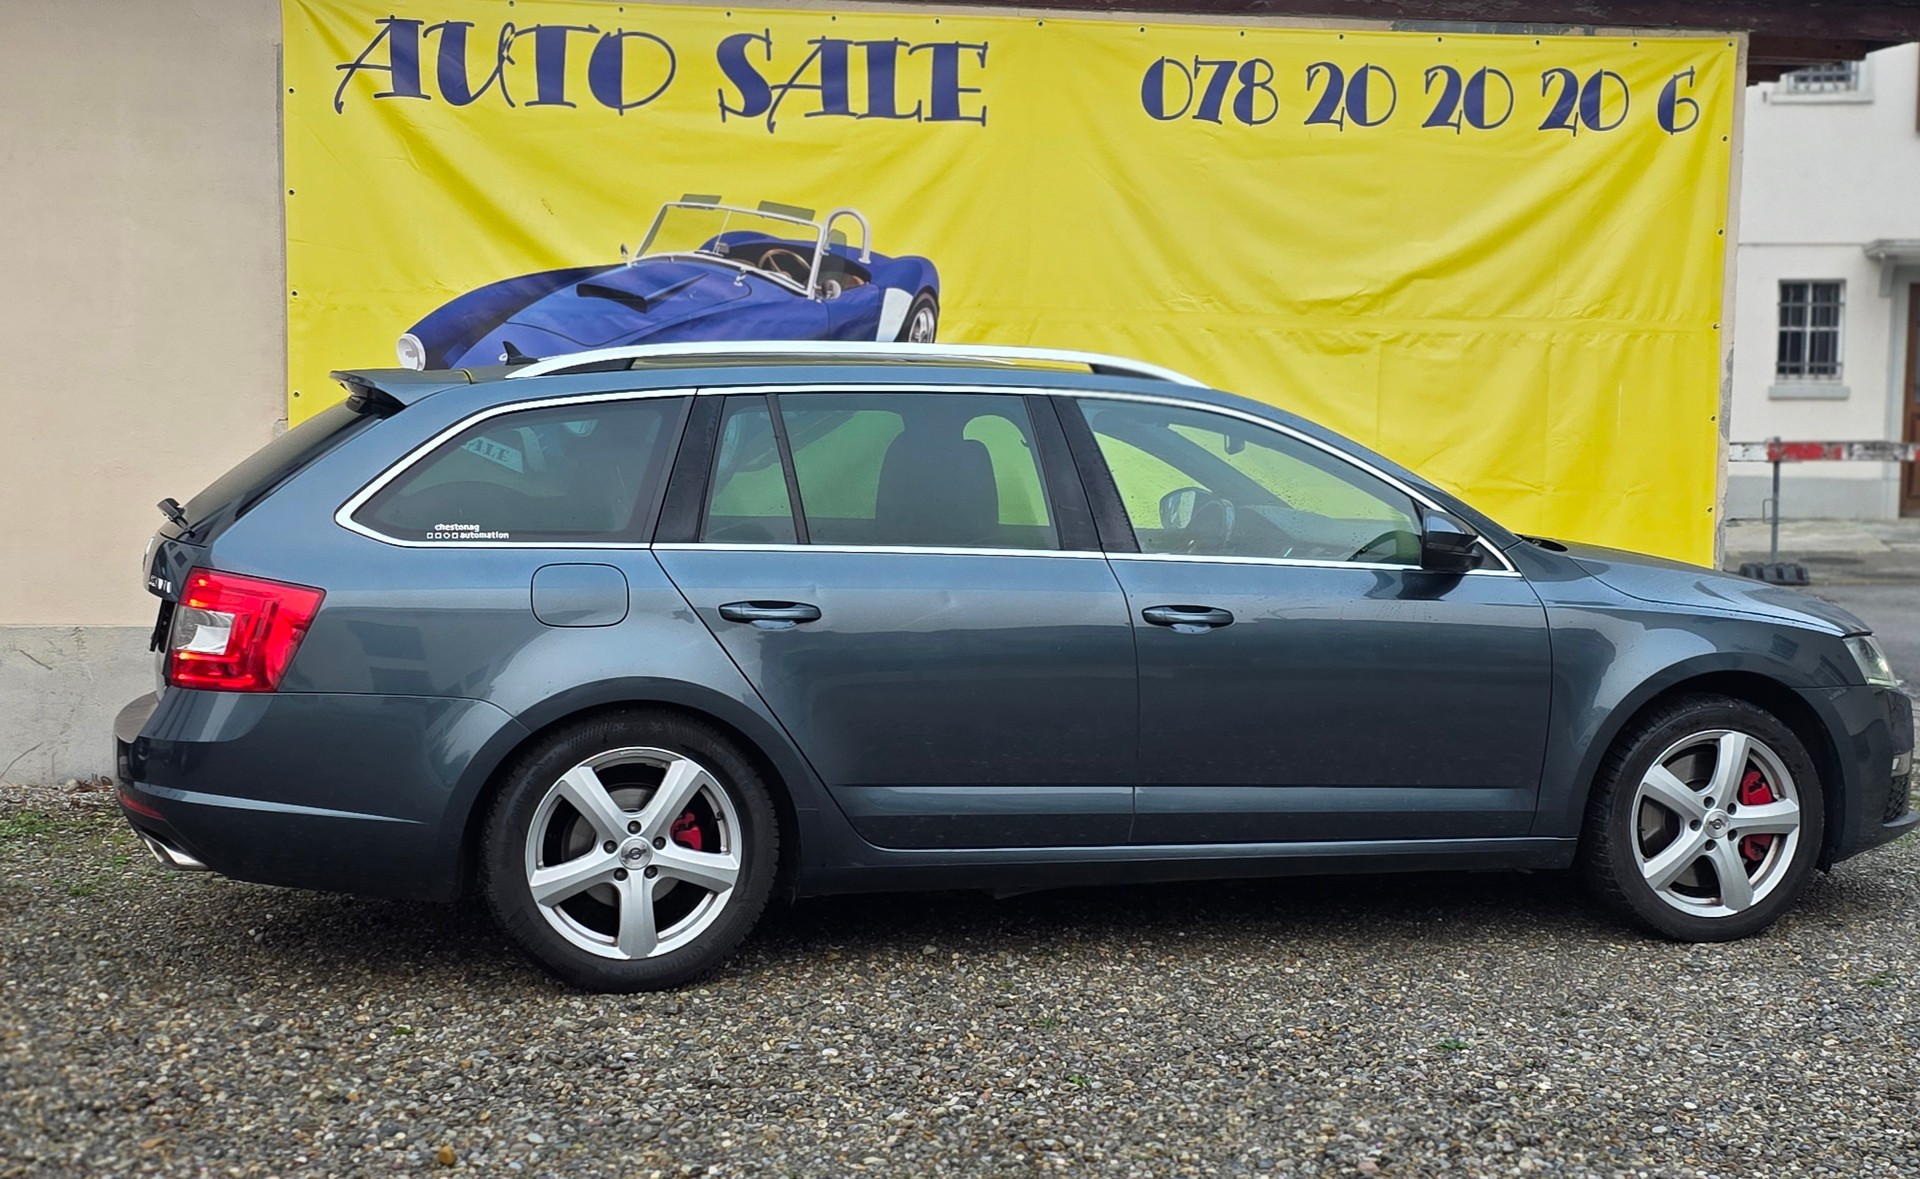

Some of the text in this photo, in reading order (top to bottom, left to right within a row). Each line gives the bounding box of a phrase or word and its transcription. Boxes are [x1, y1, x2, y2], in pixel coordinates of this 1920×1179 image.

[335, 15, 989, 133] AUTO SALE
[1141, 56, 1700, 136] 078 20 20 20 6
[459, 531, 510, 539] automation
